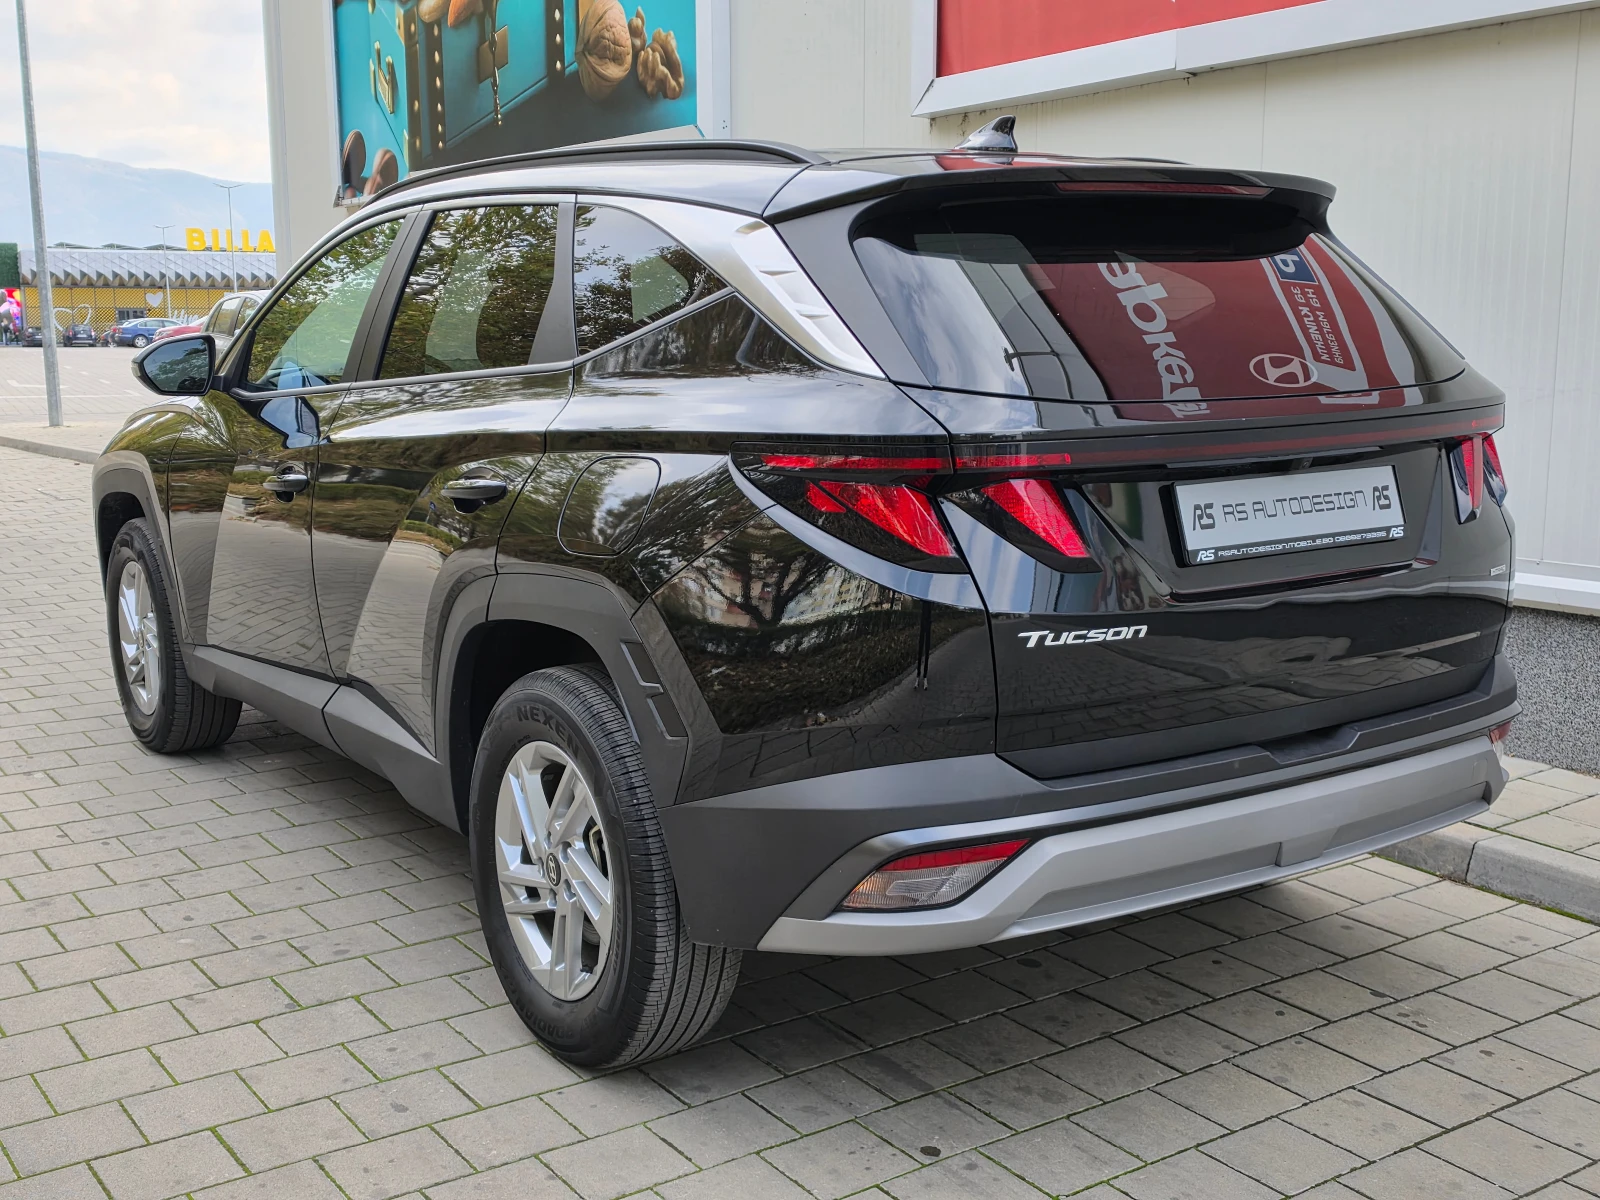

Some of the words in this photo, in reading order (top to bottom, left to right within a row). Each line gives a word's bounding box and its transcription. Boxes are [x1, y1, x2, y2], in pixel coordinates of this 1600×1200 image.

[185, 227, 276, 252] BILLA
[1193, 502, 1215, 531] RS
[1222, 503, 1248, 522] RS
[1252, 490, 1367, 520] AUTODESIGN
[1373, 485, 1391, 511] RS
[1197, 549, 1215, 562] RS
[1389, 527, 1404, 538] RS
[517, 706, 580, 758] NEXEN
